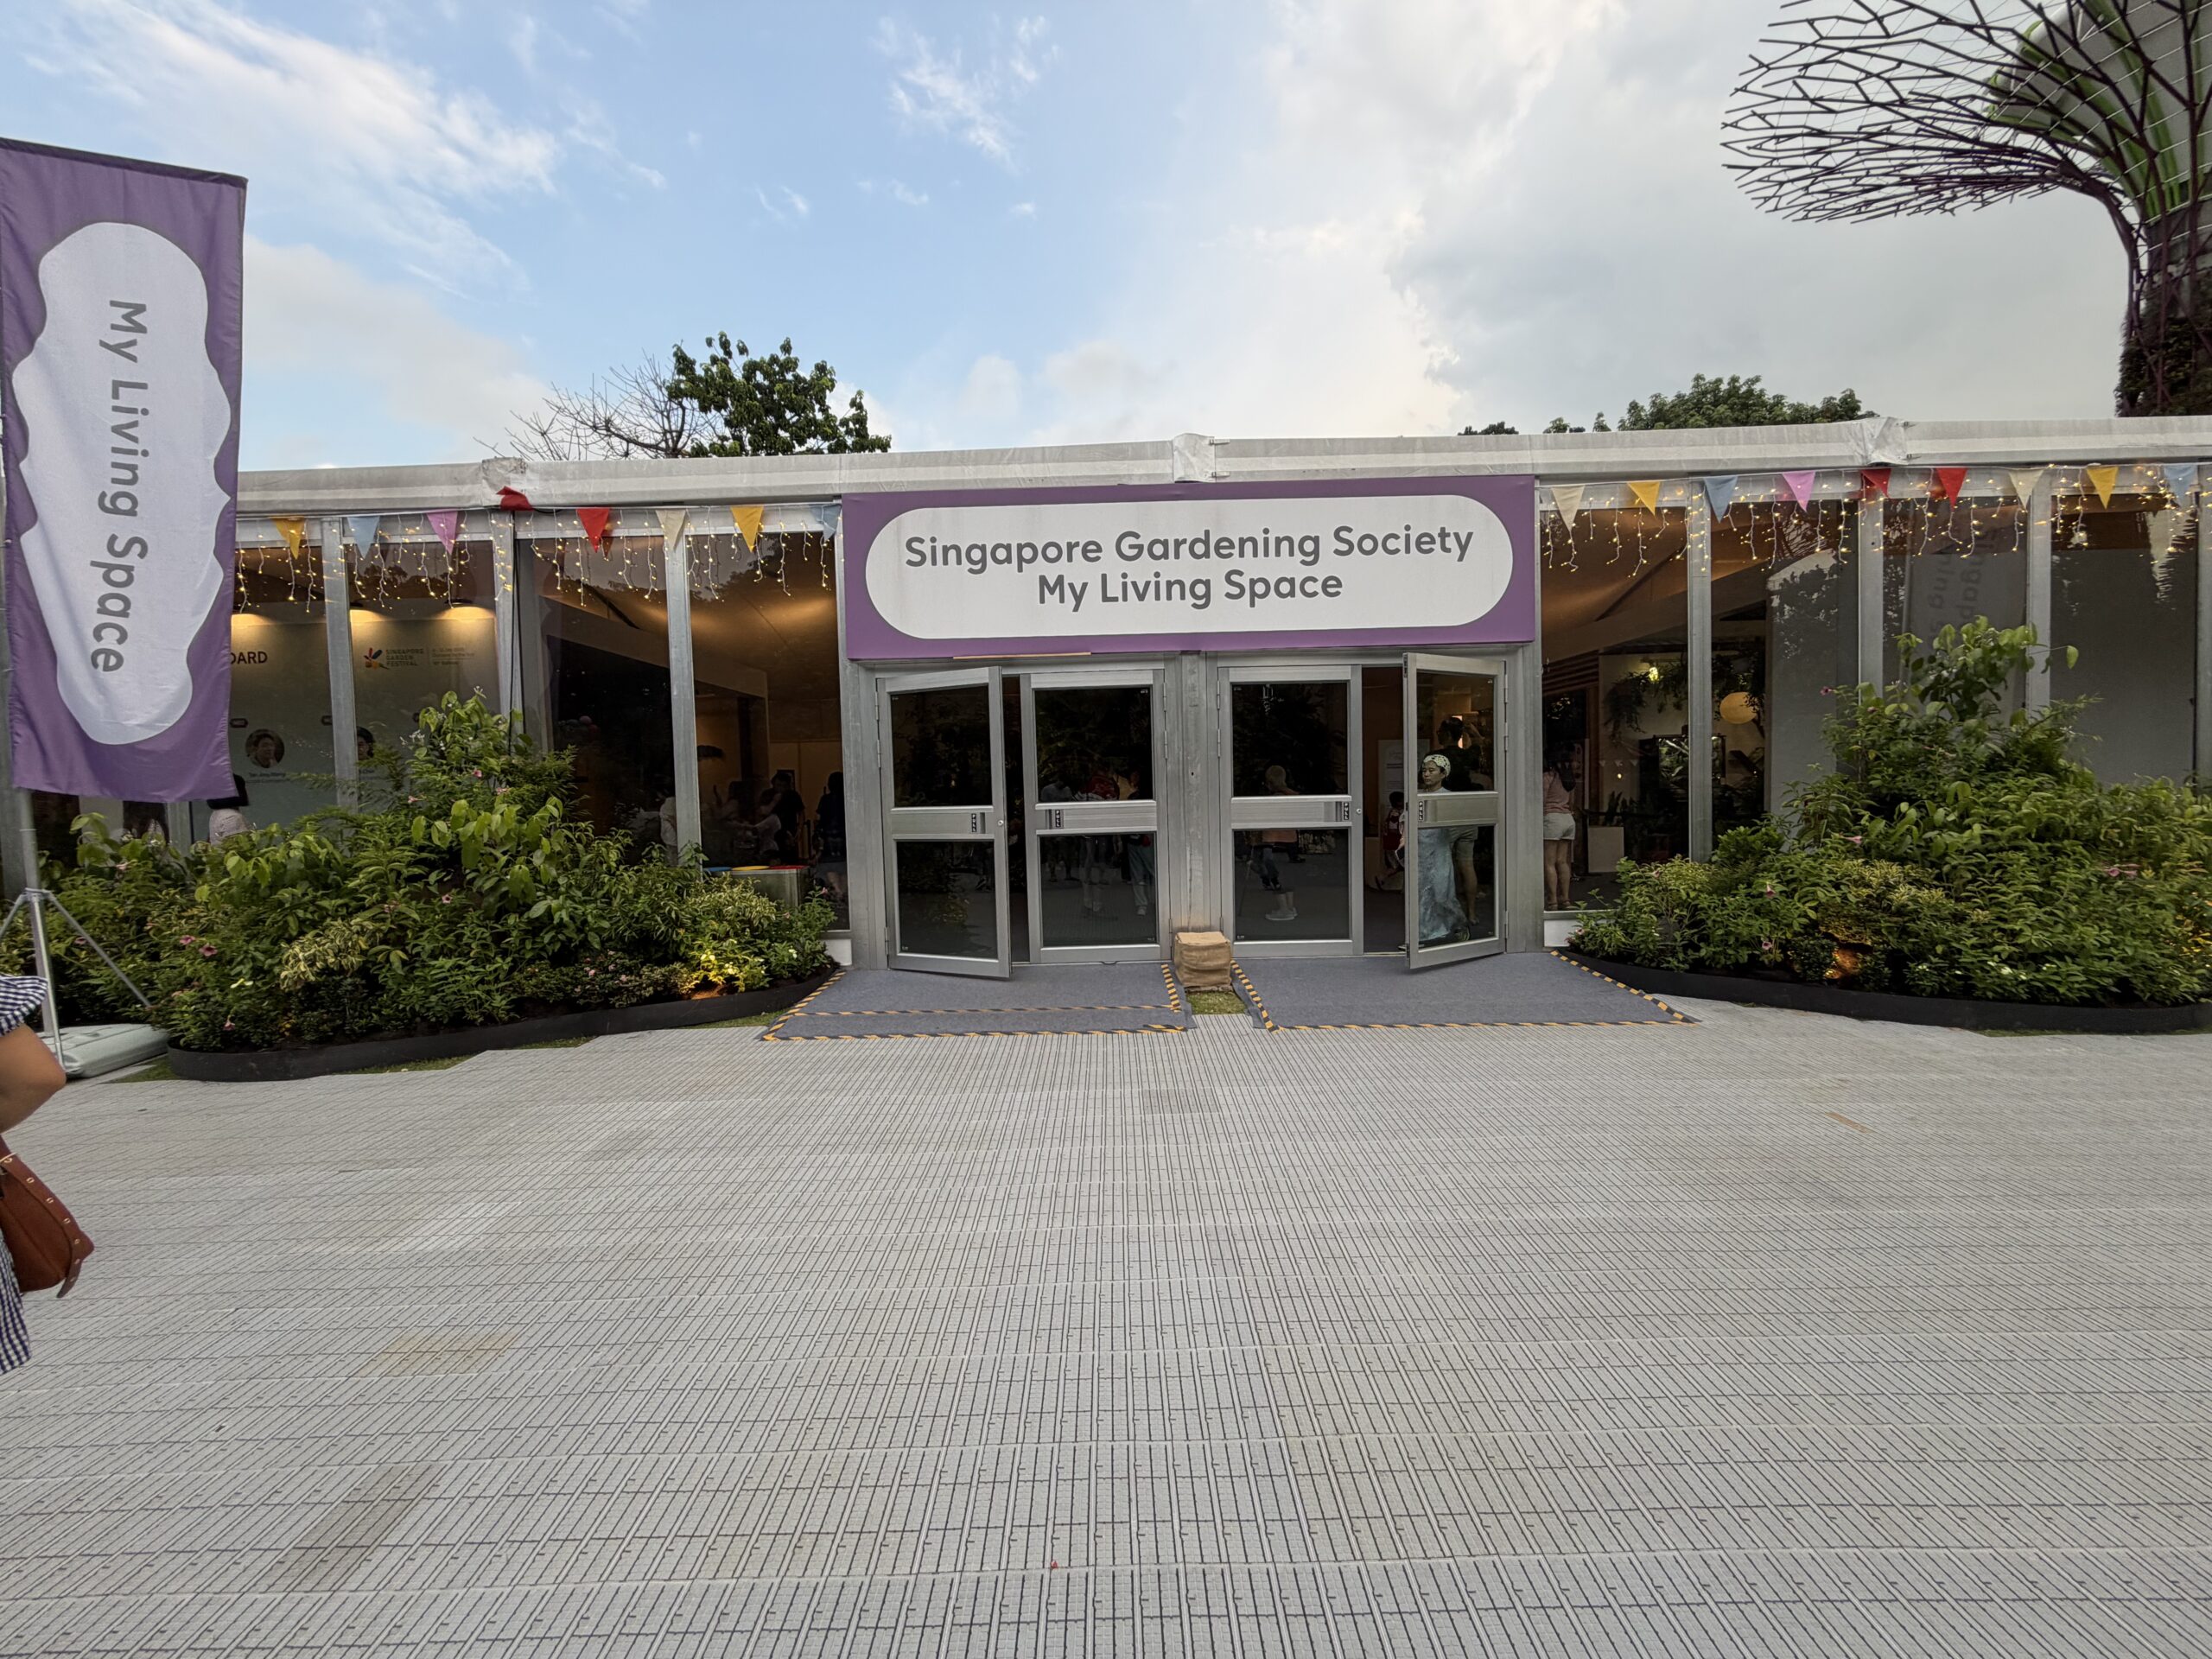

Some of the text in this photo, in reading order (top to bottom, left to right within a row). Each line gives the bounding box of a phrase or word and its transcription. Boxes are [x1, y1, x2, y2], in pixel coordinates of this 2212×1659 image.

[90, 300, 149, 672] My Living Space
[906, 524, 1473, 575] Singapore Gardening Society
[1039, 569, 1343, 612] My Living Space
